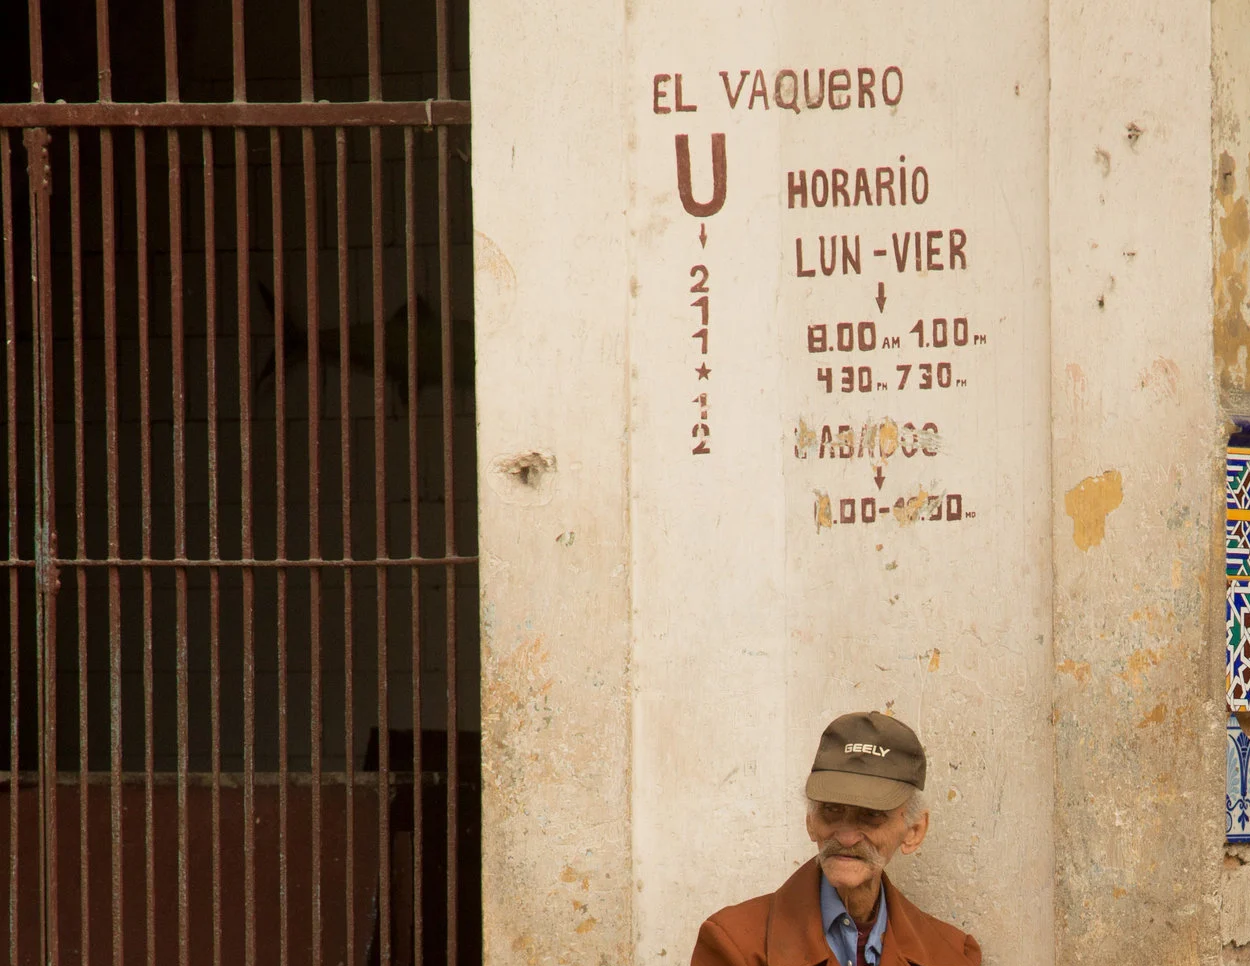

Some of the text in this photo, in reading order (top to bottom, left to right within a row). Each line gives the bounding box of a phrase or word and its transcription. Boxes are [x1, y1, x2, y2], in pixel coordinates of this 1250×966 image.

[653, 73, 697, 114] EL
[796, 234, 861, 277] LUN
[807, 321, 877, 353] 8.00
[882, 336, 901, 349] AM
[844, 743, 890, 757] GEELY
